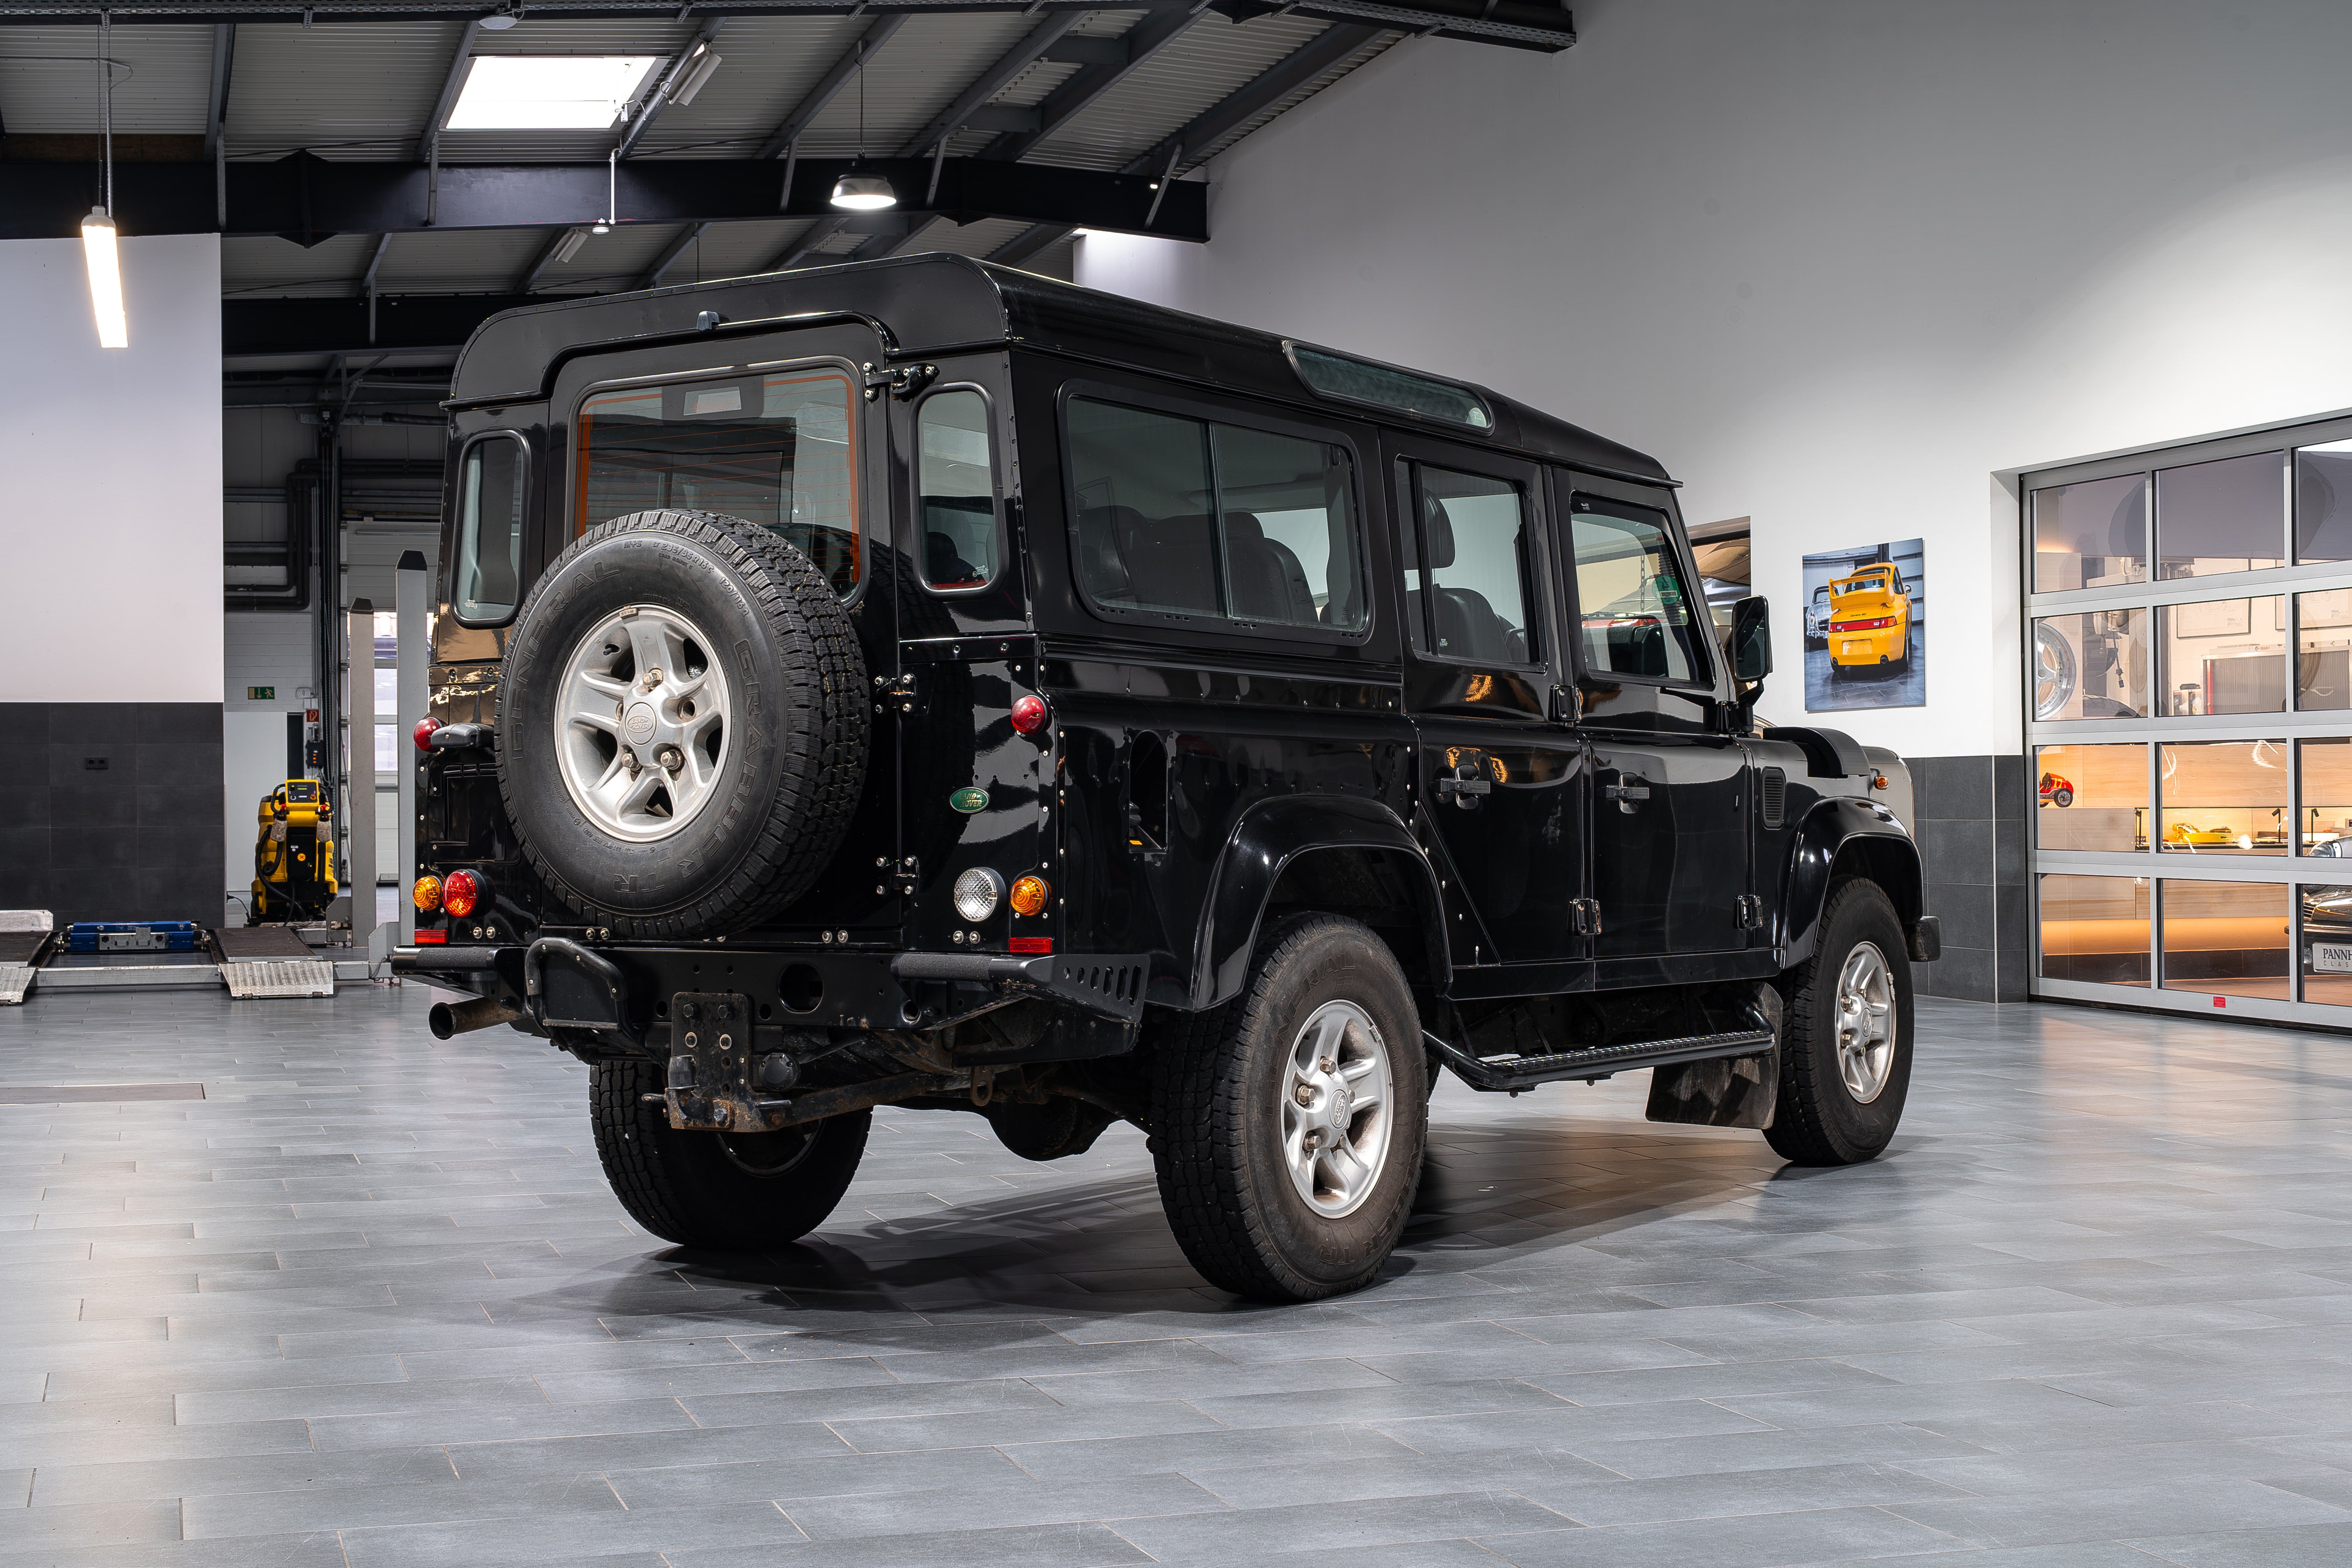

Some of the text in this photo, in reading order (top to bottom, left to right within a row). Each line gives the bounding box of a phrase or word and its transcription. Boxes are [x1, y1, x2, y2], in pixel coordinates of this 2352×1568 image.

[624, 540, 643, 549] M+S
[510, 561, 620, 760] GENERAL
[677, 639, 764, 879] GRABBER
[614, 872, 666, 894] TR
[1265, 953, 1356, 1116] GENERAL
